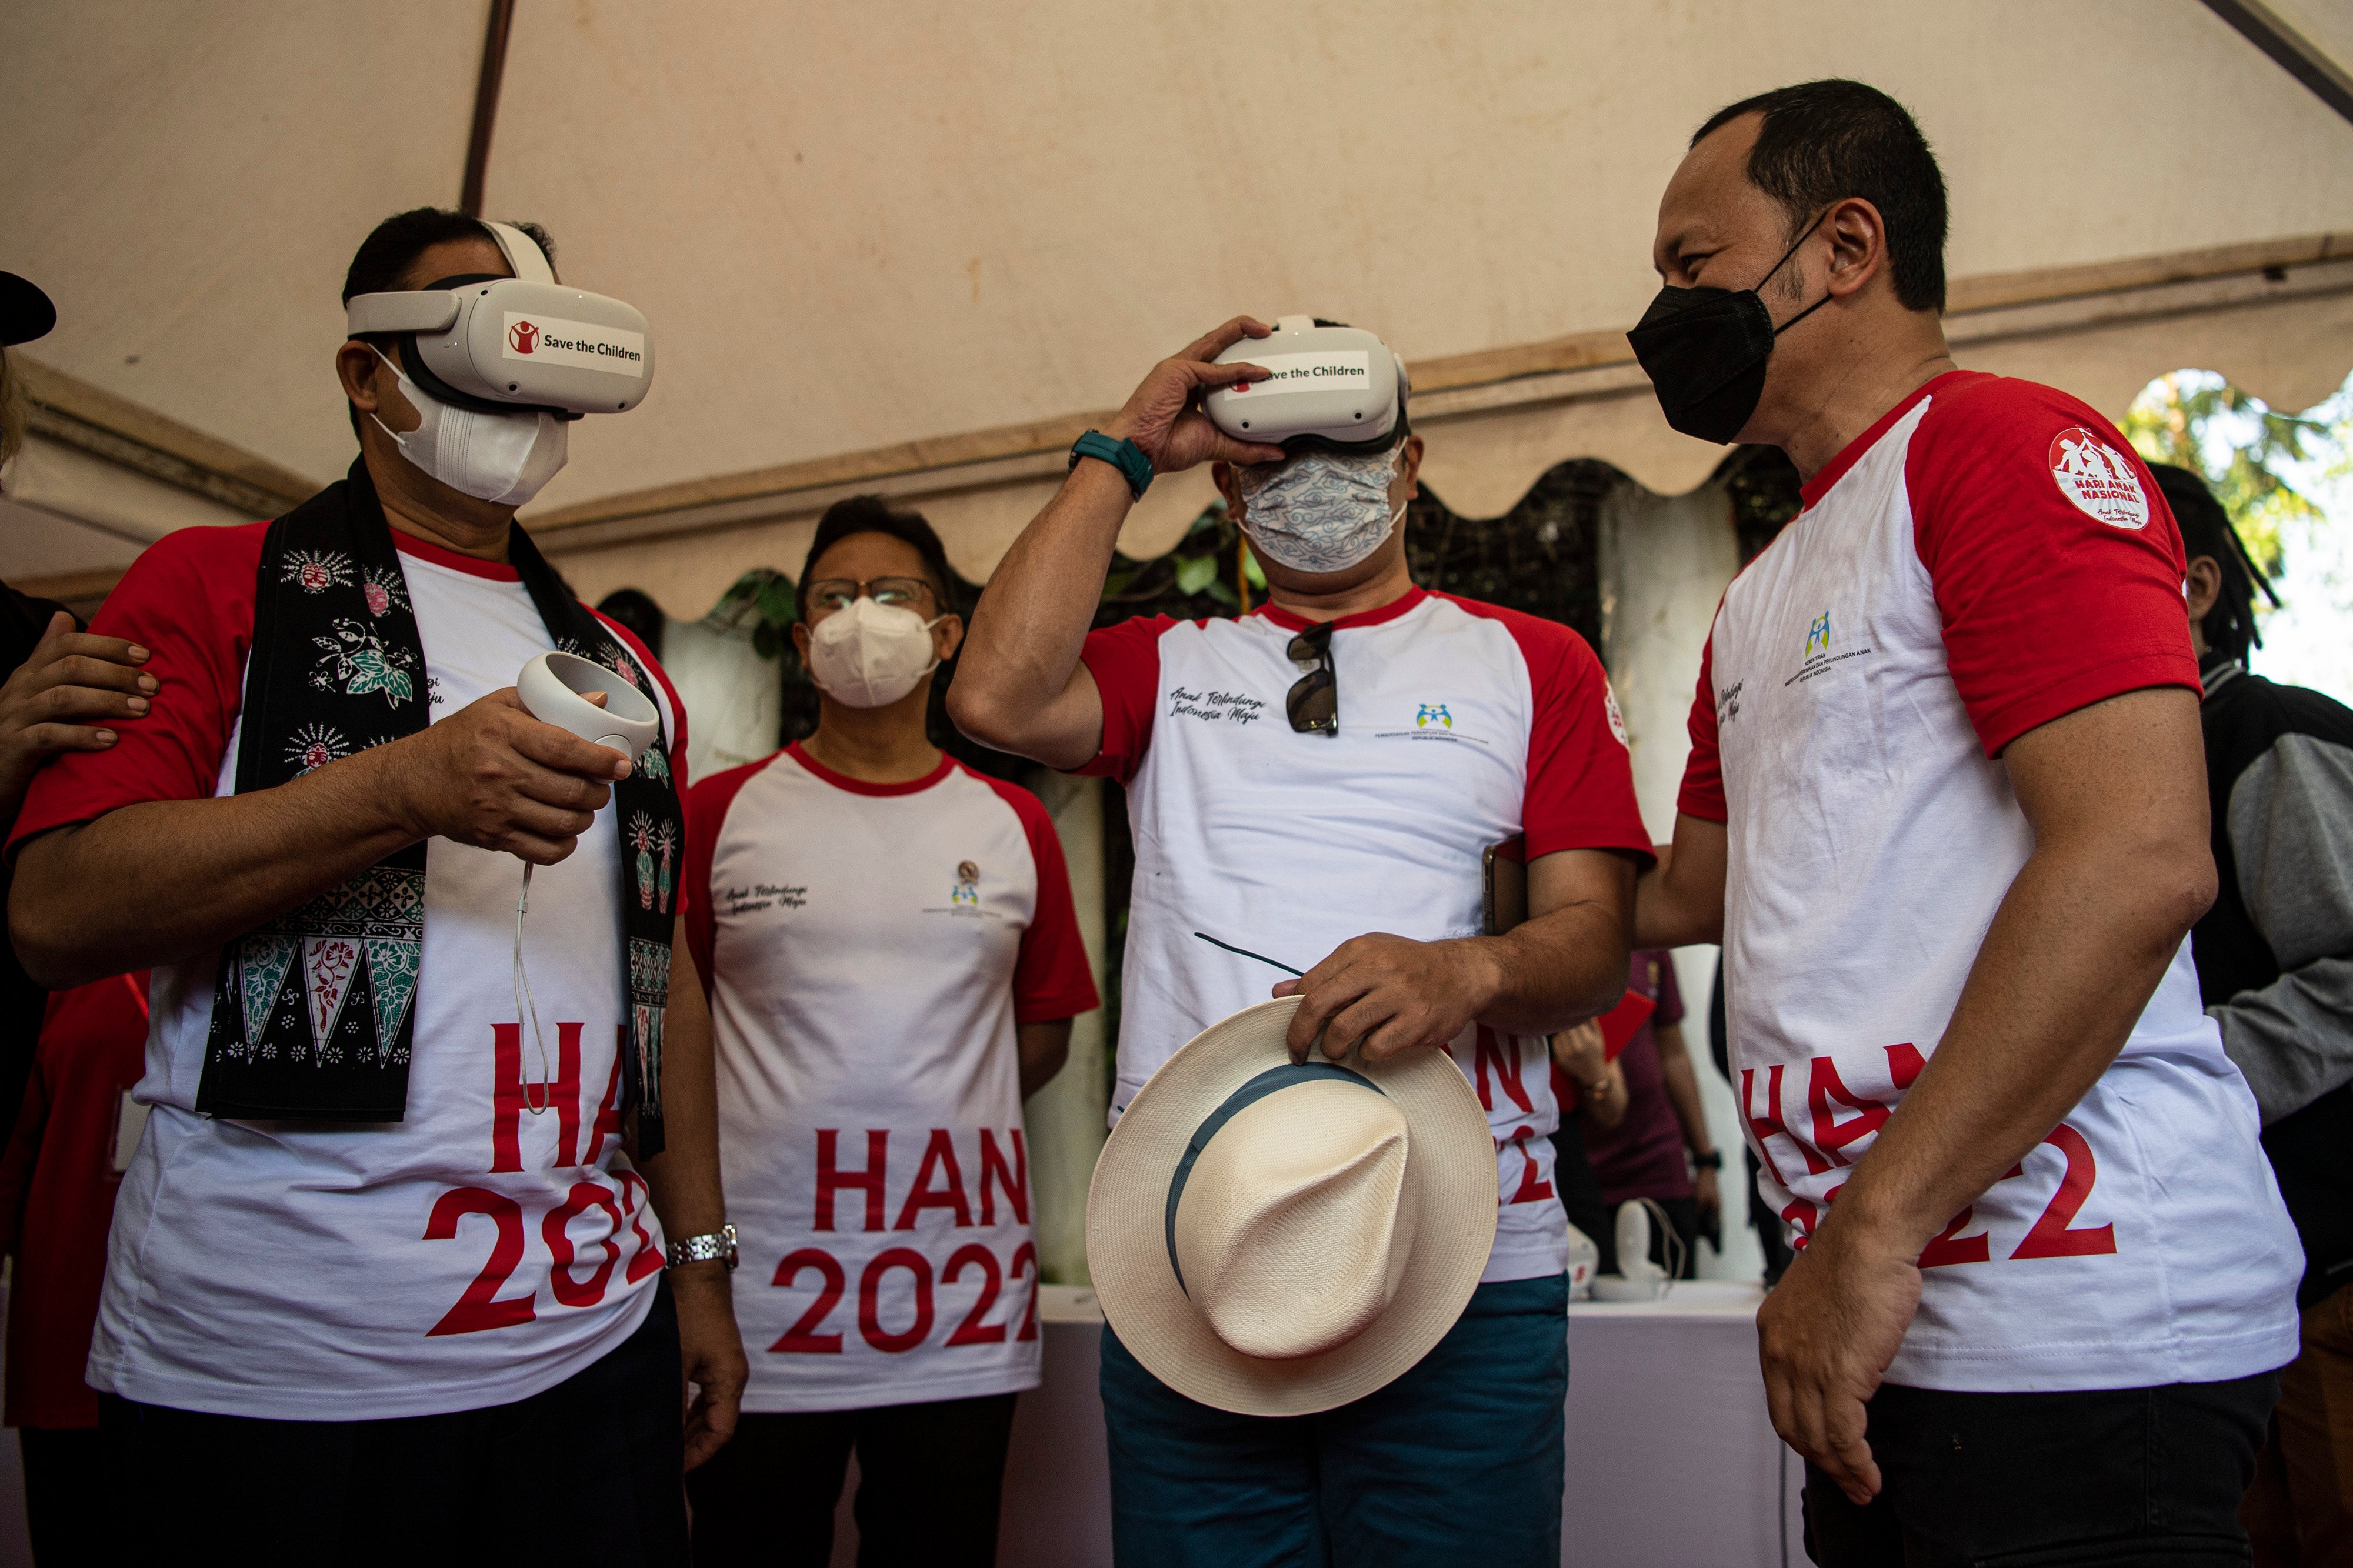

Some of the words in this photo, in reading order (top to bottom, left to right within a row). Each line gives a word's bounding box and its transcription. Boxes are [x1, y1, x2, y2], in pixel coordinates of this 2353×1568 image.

[544, 335, 573, 349] Save
[576, 340, 595, 353] the
[597, 343, 641, 362] Children
[1261, 372, 1287, 381] ave
[1291, 368, 1309, 378] the
[1312, 366, 1364, 377] Children
[2075, 479, 2105, 489] HARI
[2108, 480, 2137, 493] ANAK
[2081, 490, 2140, 503] NASIONAL
[1824, 652, 1855, 665] PERLINDUNGAN
[1857, 648, 1872, 656] ANAK
[1169, 687, 1202, 702] Anak
[1169, 700, 1224, 721] Indonesia
[1228, 706, 1260, 725] Maju
[488, 1022, 628, 1173] HA
[1741, 1043, 1927, 1186] HA
[812, 1127, 1031, 1233] HAN
